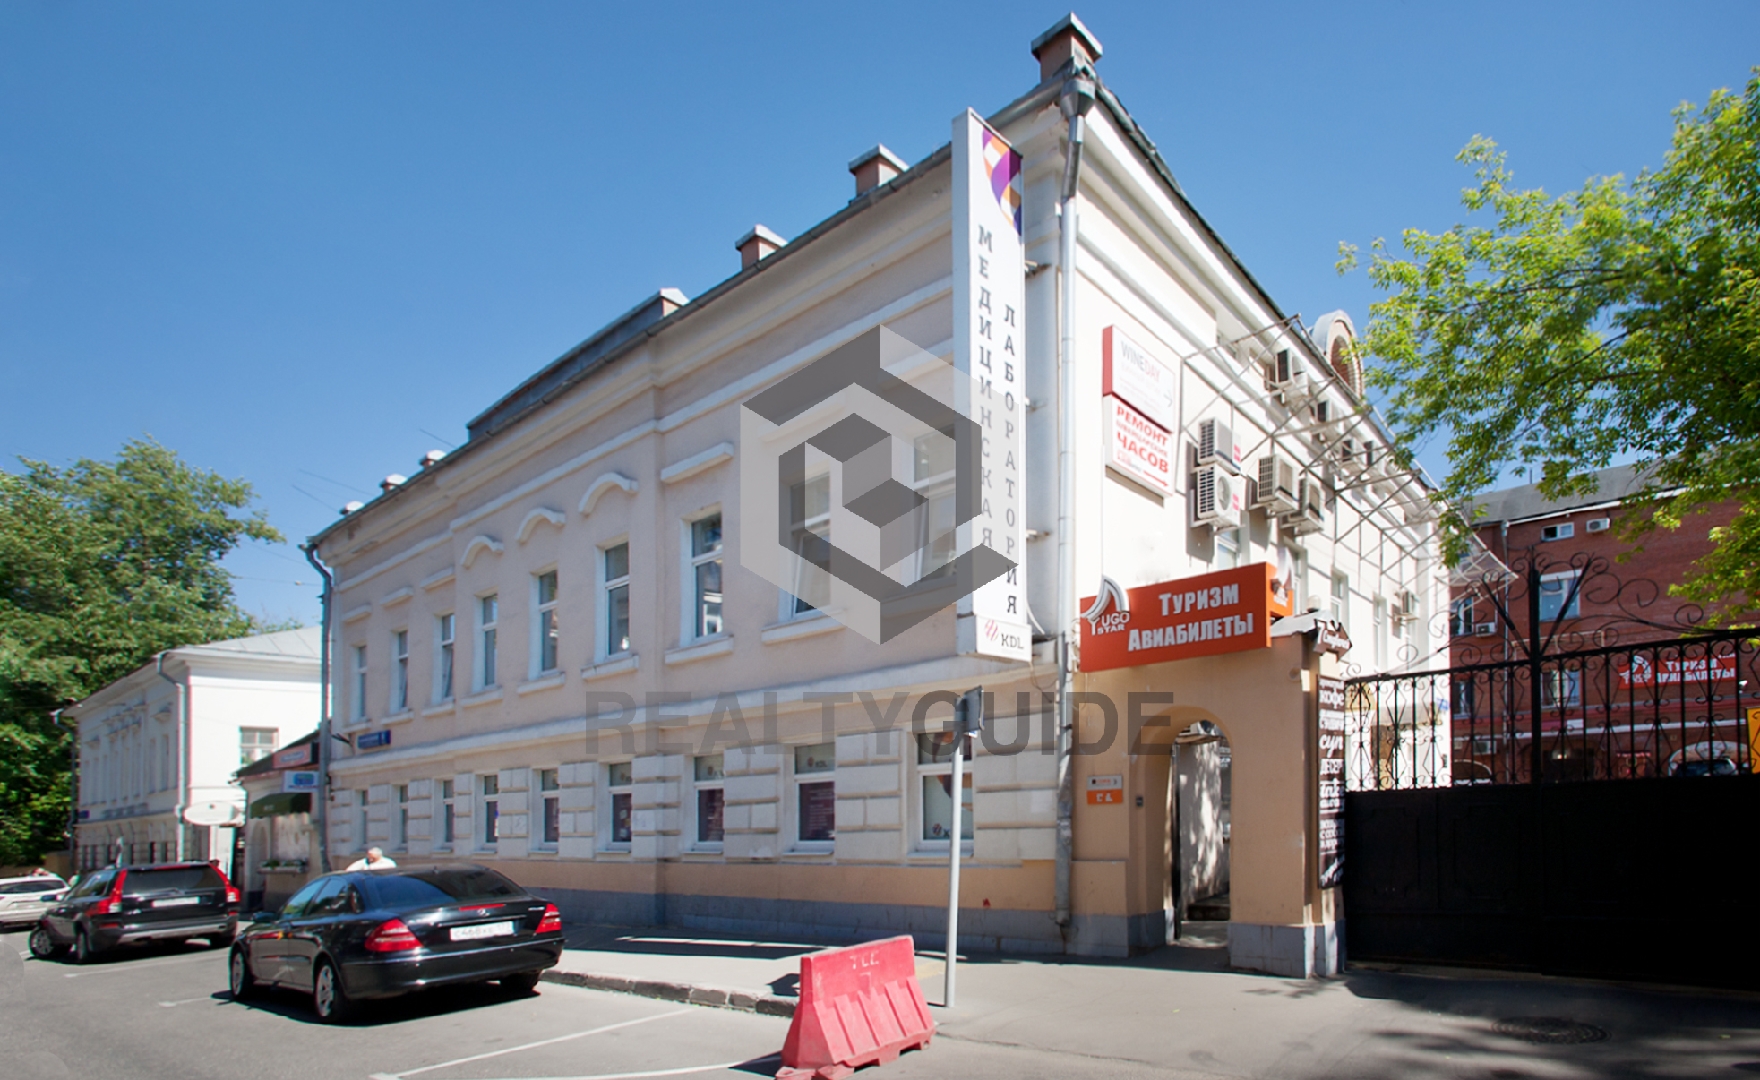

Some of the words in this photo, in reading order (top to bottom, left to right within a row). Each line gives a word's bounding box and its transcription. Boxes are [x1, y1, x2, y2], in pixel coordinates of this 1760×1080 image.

[978, 224, 994, 548] МЕДИЦИНСКАЯ
[1116, 405, 1168, 446] РЕМОНТ
[1003, 303, 1018, 615] ЛАБОРАТОРИЯ
[1117, 430, 1169, 473] ЧАСОВ
[1158, 583, 1240, 616] ТУРИЗМ
[1001, 633, 1024, 650] KDL
[1128, 613, 1254, 652] АВИАБИЛЕТЫ
[1656, 667, 1736, 683] АВИБИЛЕТЫ
